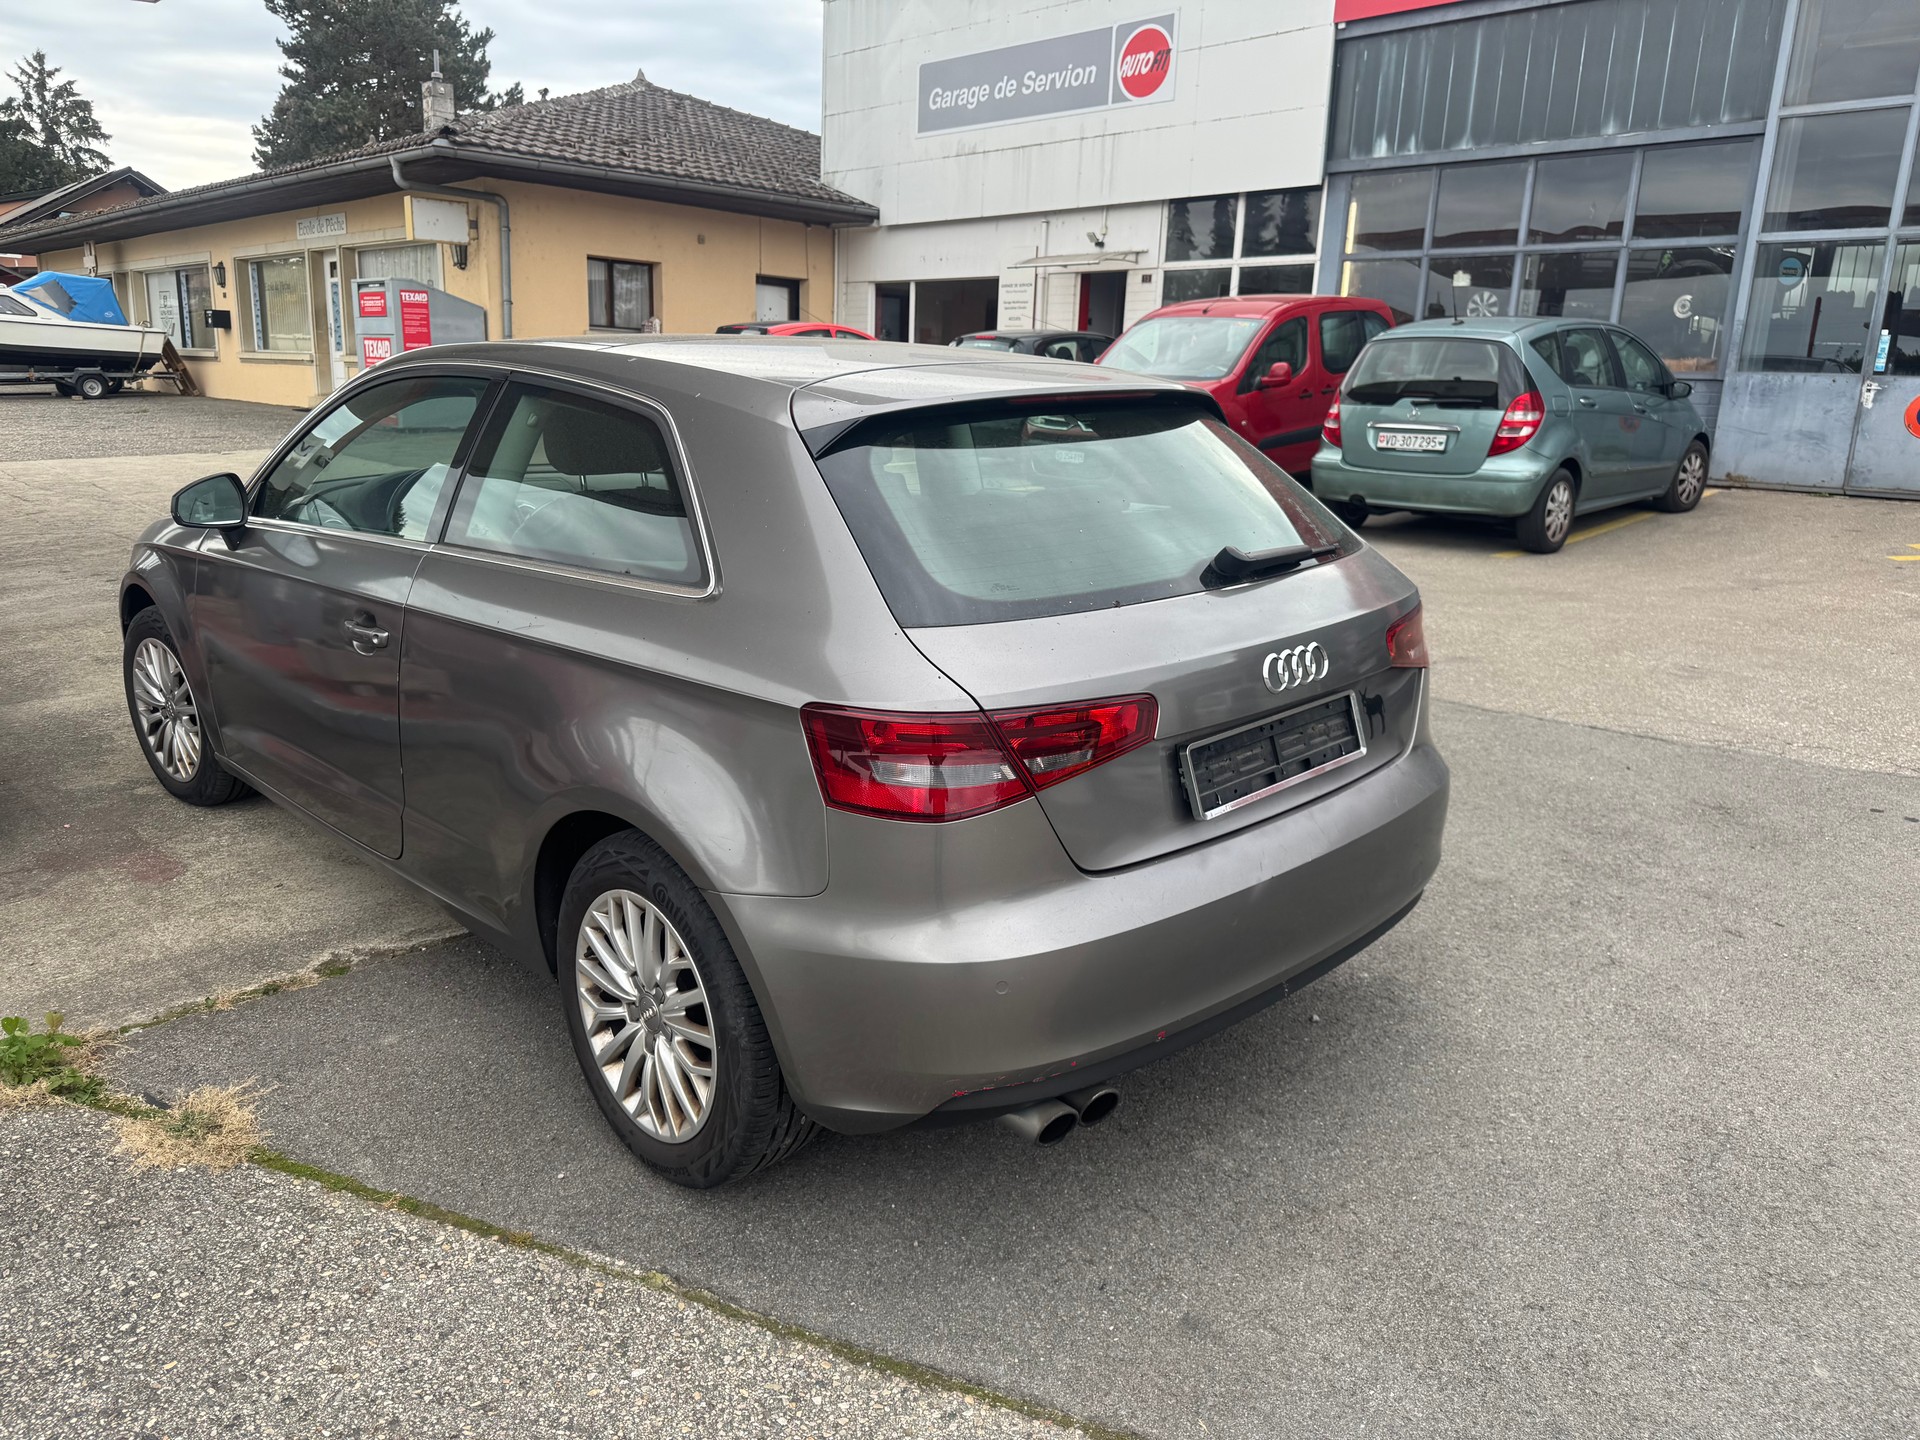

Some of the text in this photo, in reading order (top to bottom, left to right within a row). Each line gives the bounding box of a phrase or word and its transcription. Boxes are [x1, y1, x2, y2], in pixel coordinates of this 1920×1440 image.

[929, 63, 1097, 110] Garage de Servion
[317, 219, 324, 234] de
[325, 217, 345, 233] Pêche
[400, 292, 428, 302] TEXAID
[363, 340, 391, 358] TEXAID
